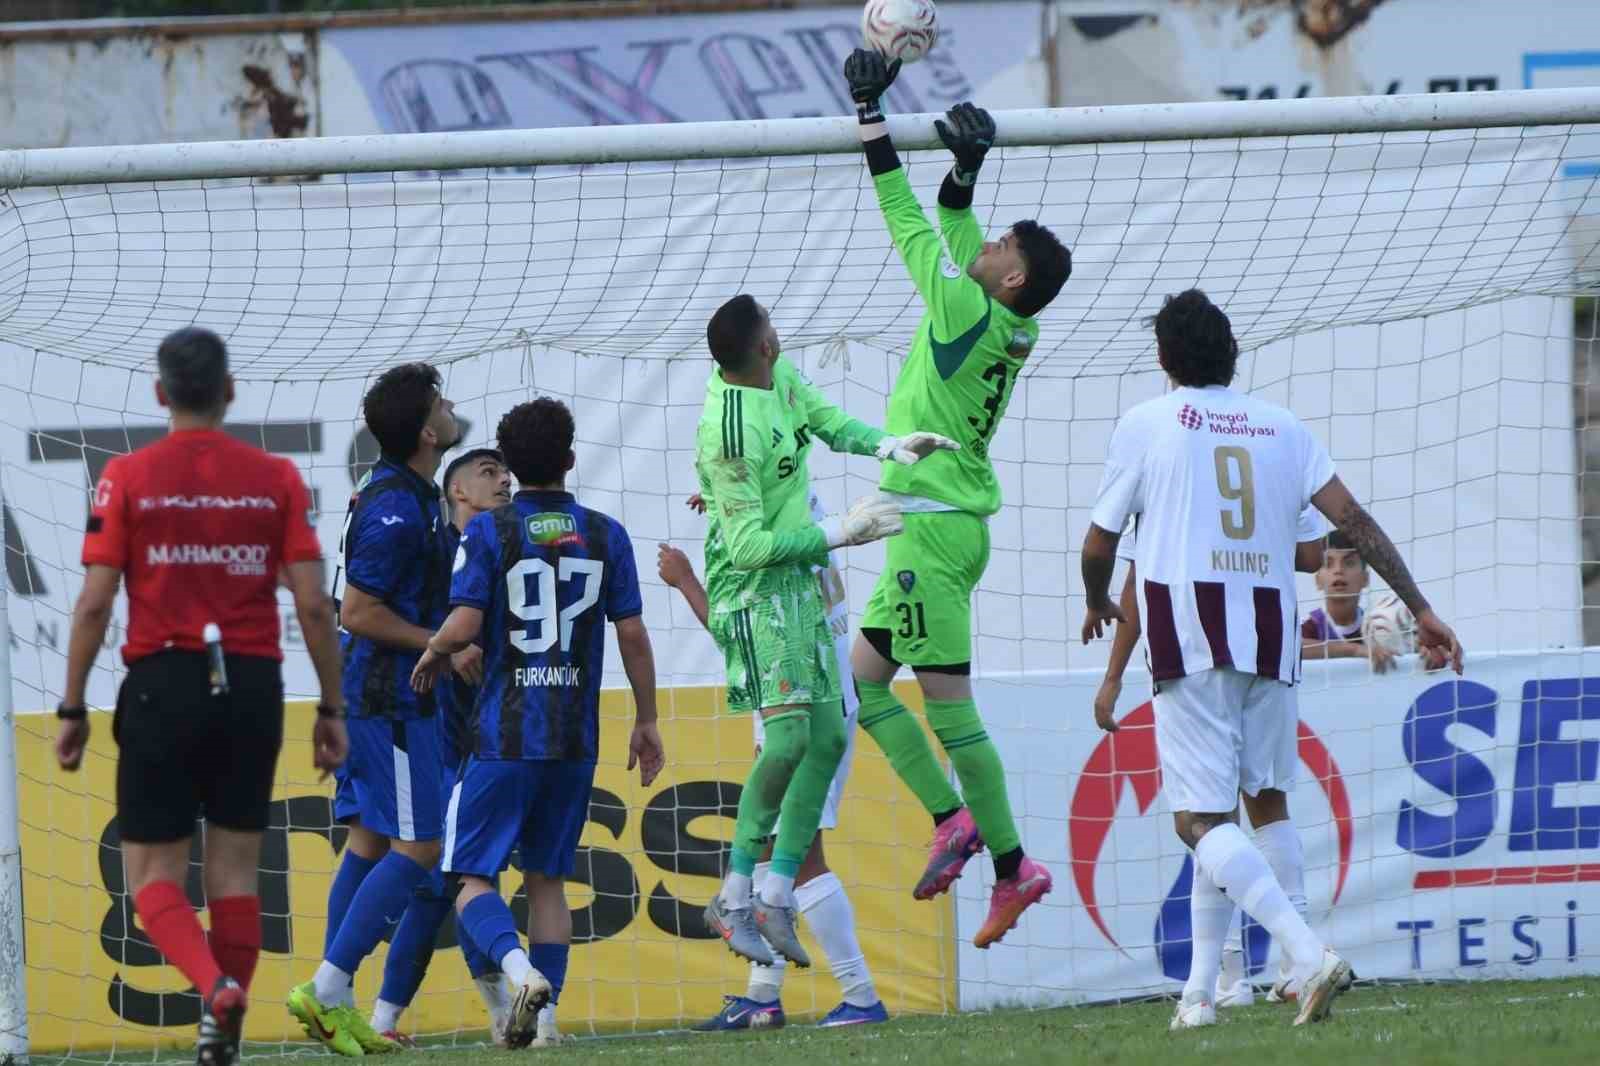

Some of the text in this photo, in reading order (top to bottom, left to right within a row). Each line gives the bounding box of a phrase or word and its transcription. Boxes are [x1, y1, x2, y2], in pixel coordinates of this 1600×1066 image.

[1213, 445, 1256, 541] 9
[529, 518, 573, 534] emu
[147, 543, 267, 567] MAHMOOD
[1211, 549, 1270, 578] KILINÇ
[505, 557, 605, 654] 97
[895, 602, 929, 639] 31
[1396, 676, 1600, 859] SE
[1396, 900, 1579, 970] TESİ
